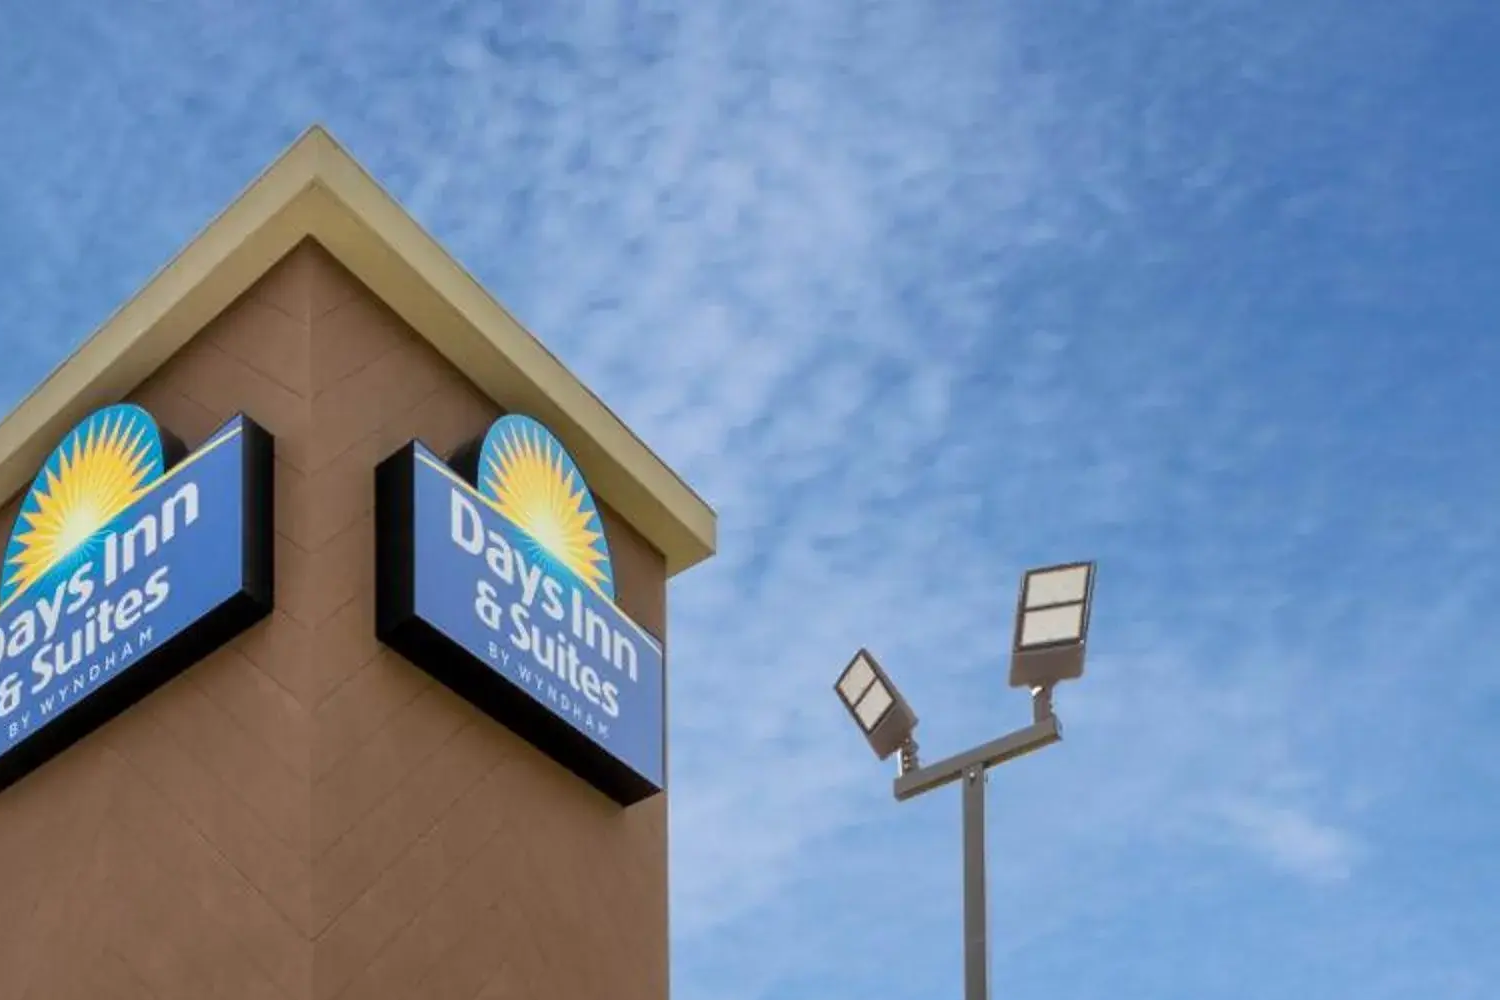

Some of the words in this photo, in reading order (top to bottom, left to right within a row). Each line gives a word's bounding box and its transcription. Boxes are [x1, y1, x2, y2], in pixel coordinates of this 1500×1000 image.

[104, 482, 199, 586] Inn
[450, 488, 564, 621] Days
[572, 586, 638, 683] Inn
[8, 710, 30, 738] BY
[40, 627, 153, 716] WYNDHAM
[31, 566, 169, 695] Suites
[475, 580, 502, 631] &
[510, 604, 619, 718] Suites
[487, 641, 509, 668] BY
[518, 668, 611, 739] WYNDHAM
